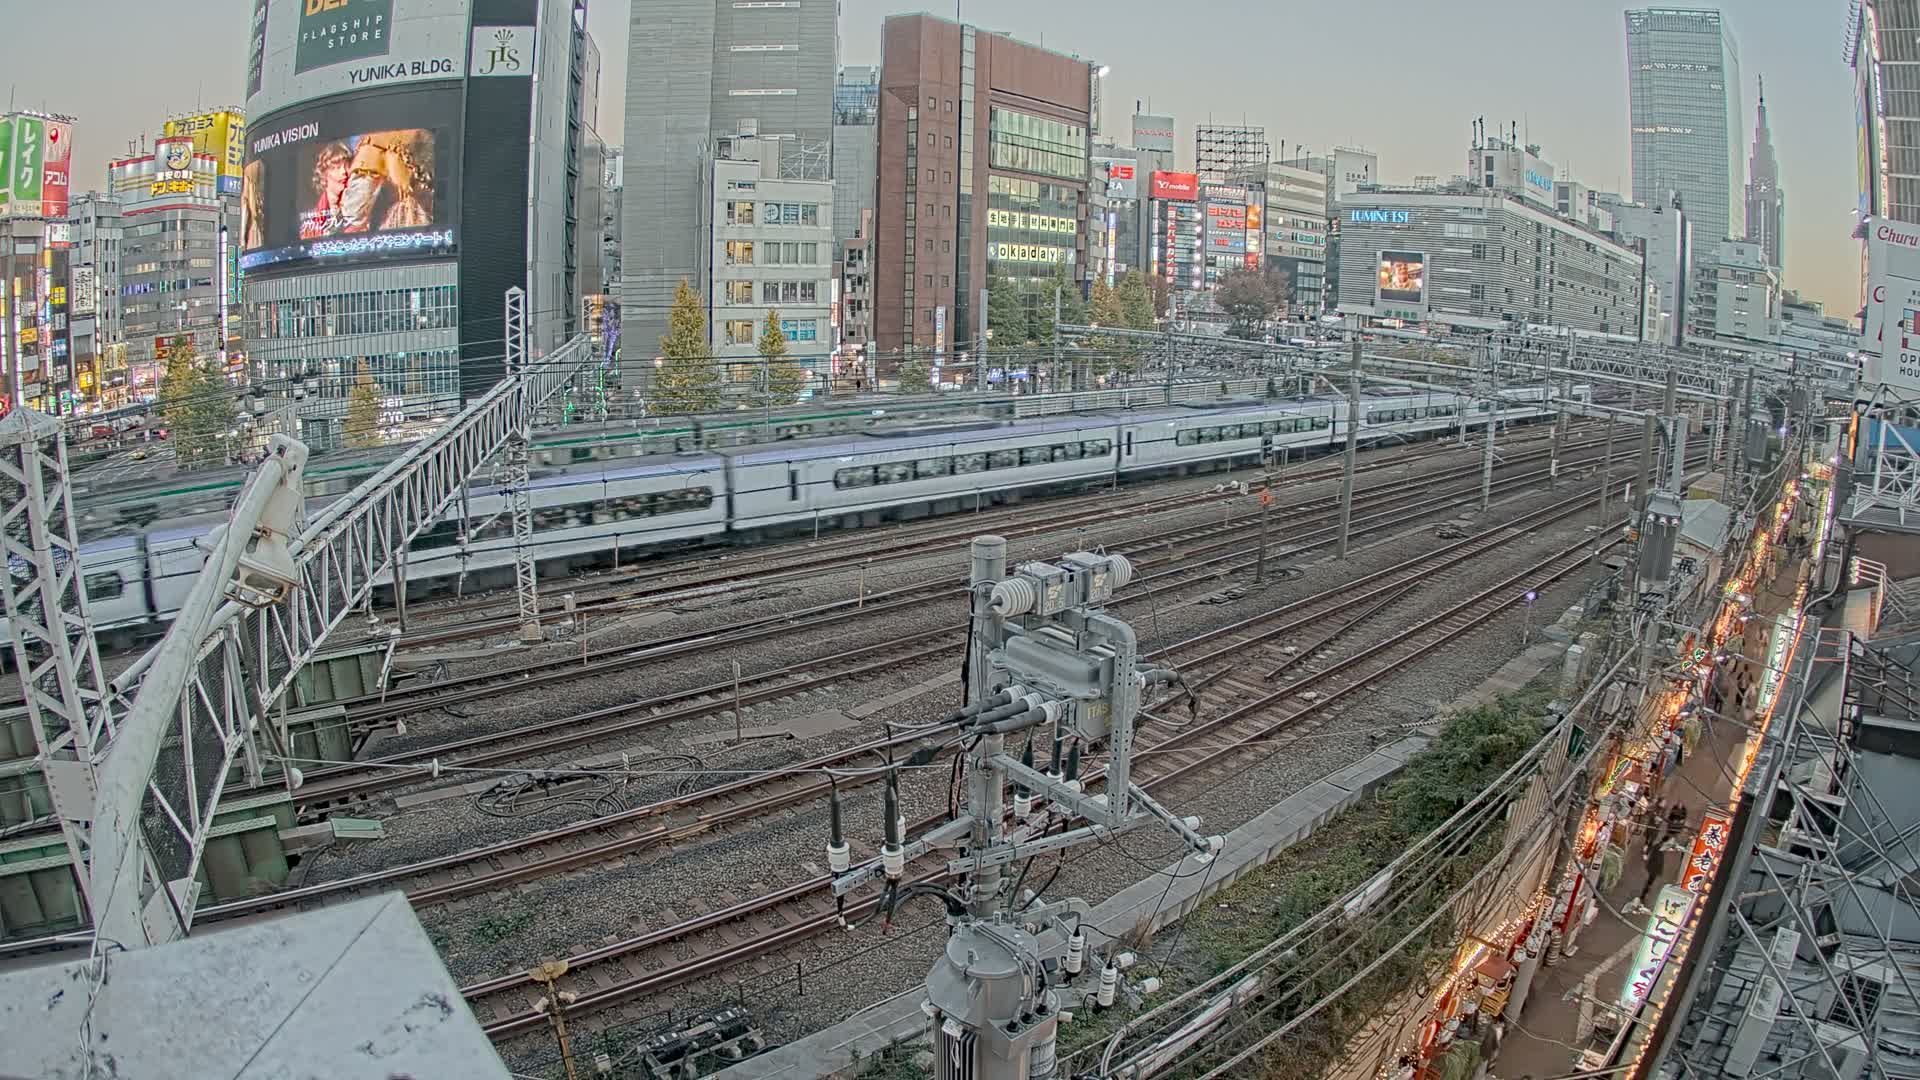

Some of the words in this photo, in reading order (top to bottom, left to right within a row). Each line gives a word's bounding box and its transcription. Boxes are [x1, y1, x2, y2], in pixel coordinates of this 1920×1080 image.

[303, 15, 383, 43] FLAGSHIP
[328, 29, 382, 48] STORE
[349, 63, 407, 84] YUNIKA
[411, 58, 455, 75] BLDG.
[253, 133, 280, 155] YUNIKA
[282, 122, 319, 145] VISION
[21, 122, 36, 189] レイク
[44, 170, 67, 186] アコム
[1351, 209, 1390, 222] LUMINE
[1392, 211, 1409, 223] EST
[1877, 225, 1918, 247] Churu
[1000, 247, 1064, 261] okadaya
